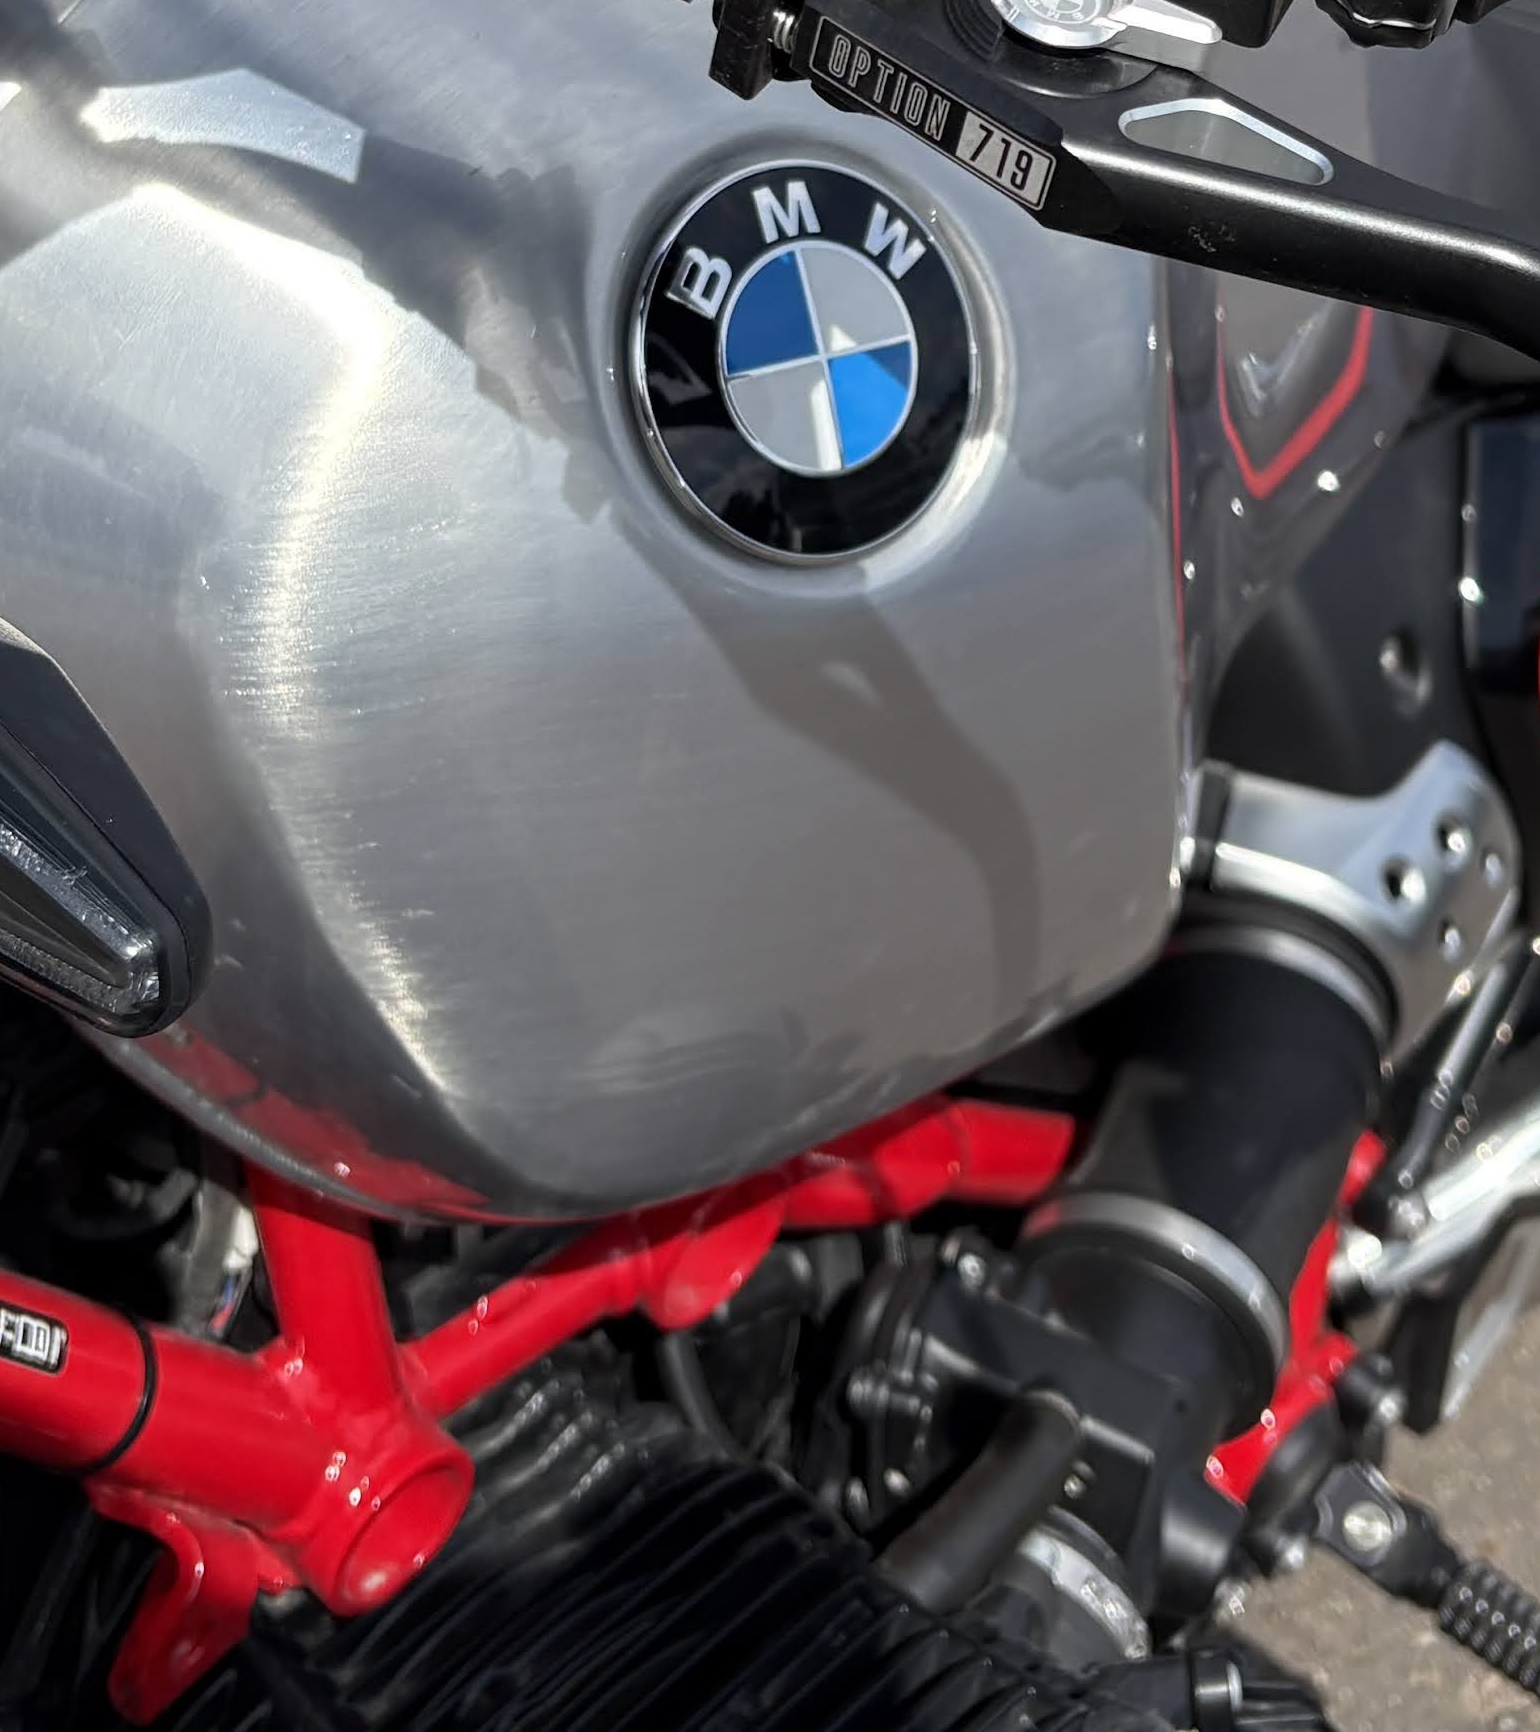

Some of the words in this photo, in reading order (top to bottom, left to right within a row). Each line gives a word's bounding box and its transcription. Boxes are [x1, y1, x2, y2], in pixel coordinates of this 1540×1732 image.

[828, 35, 950, 141] OPTION
[969, 124, 1034, 192] 719
[664, 180, 926, 320] BMW
